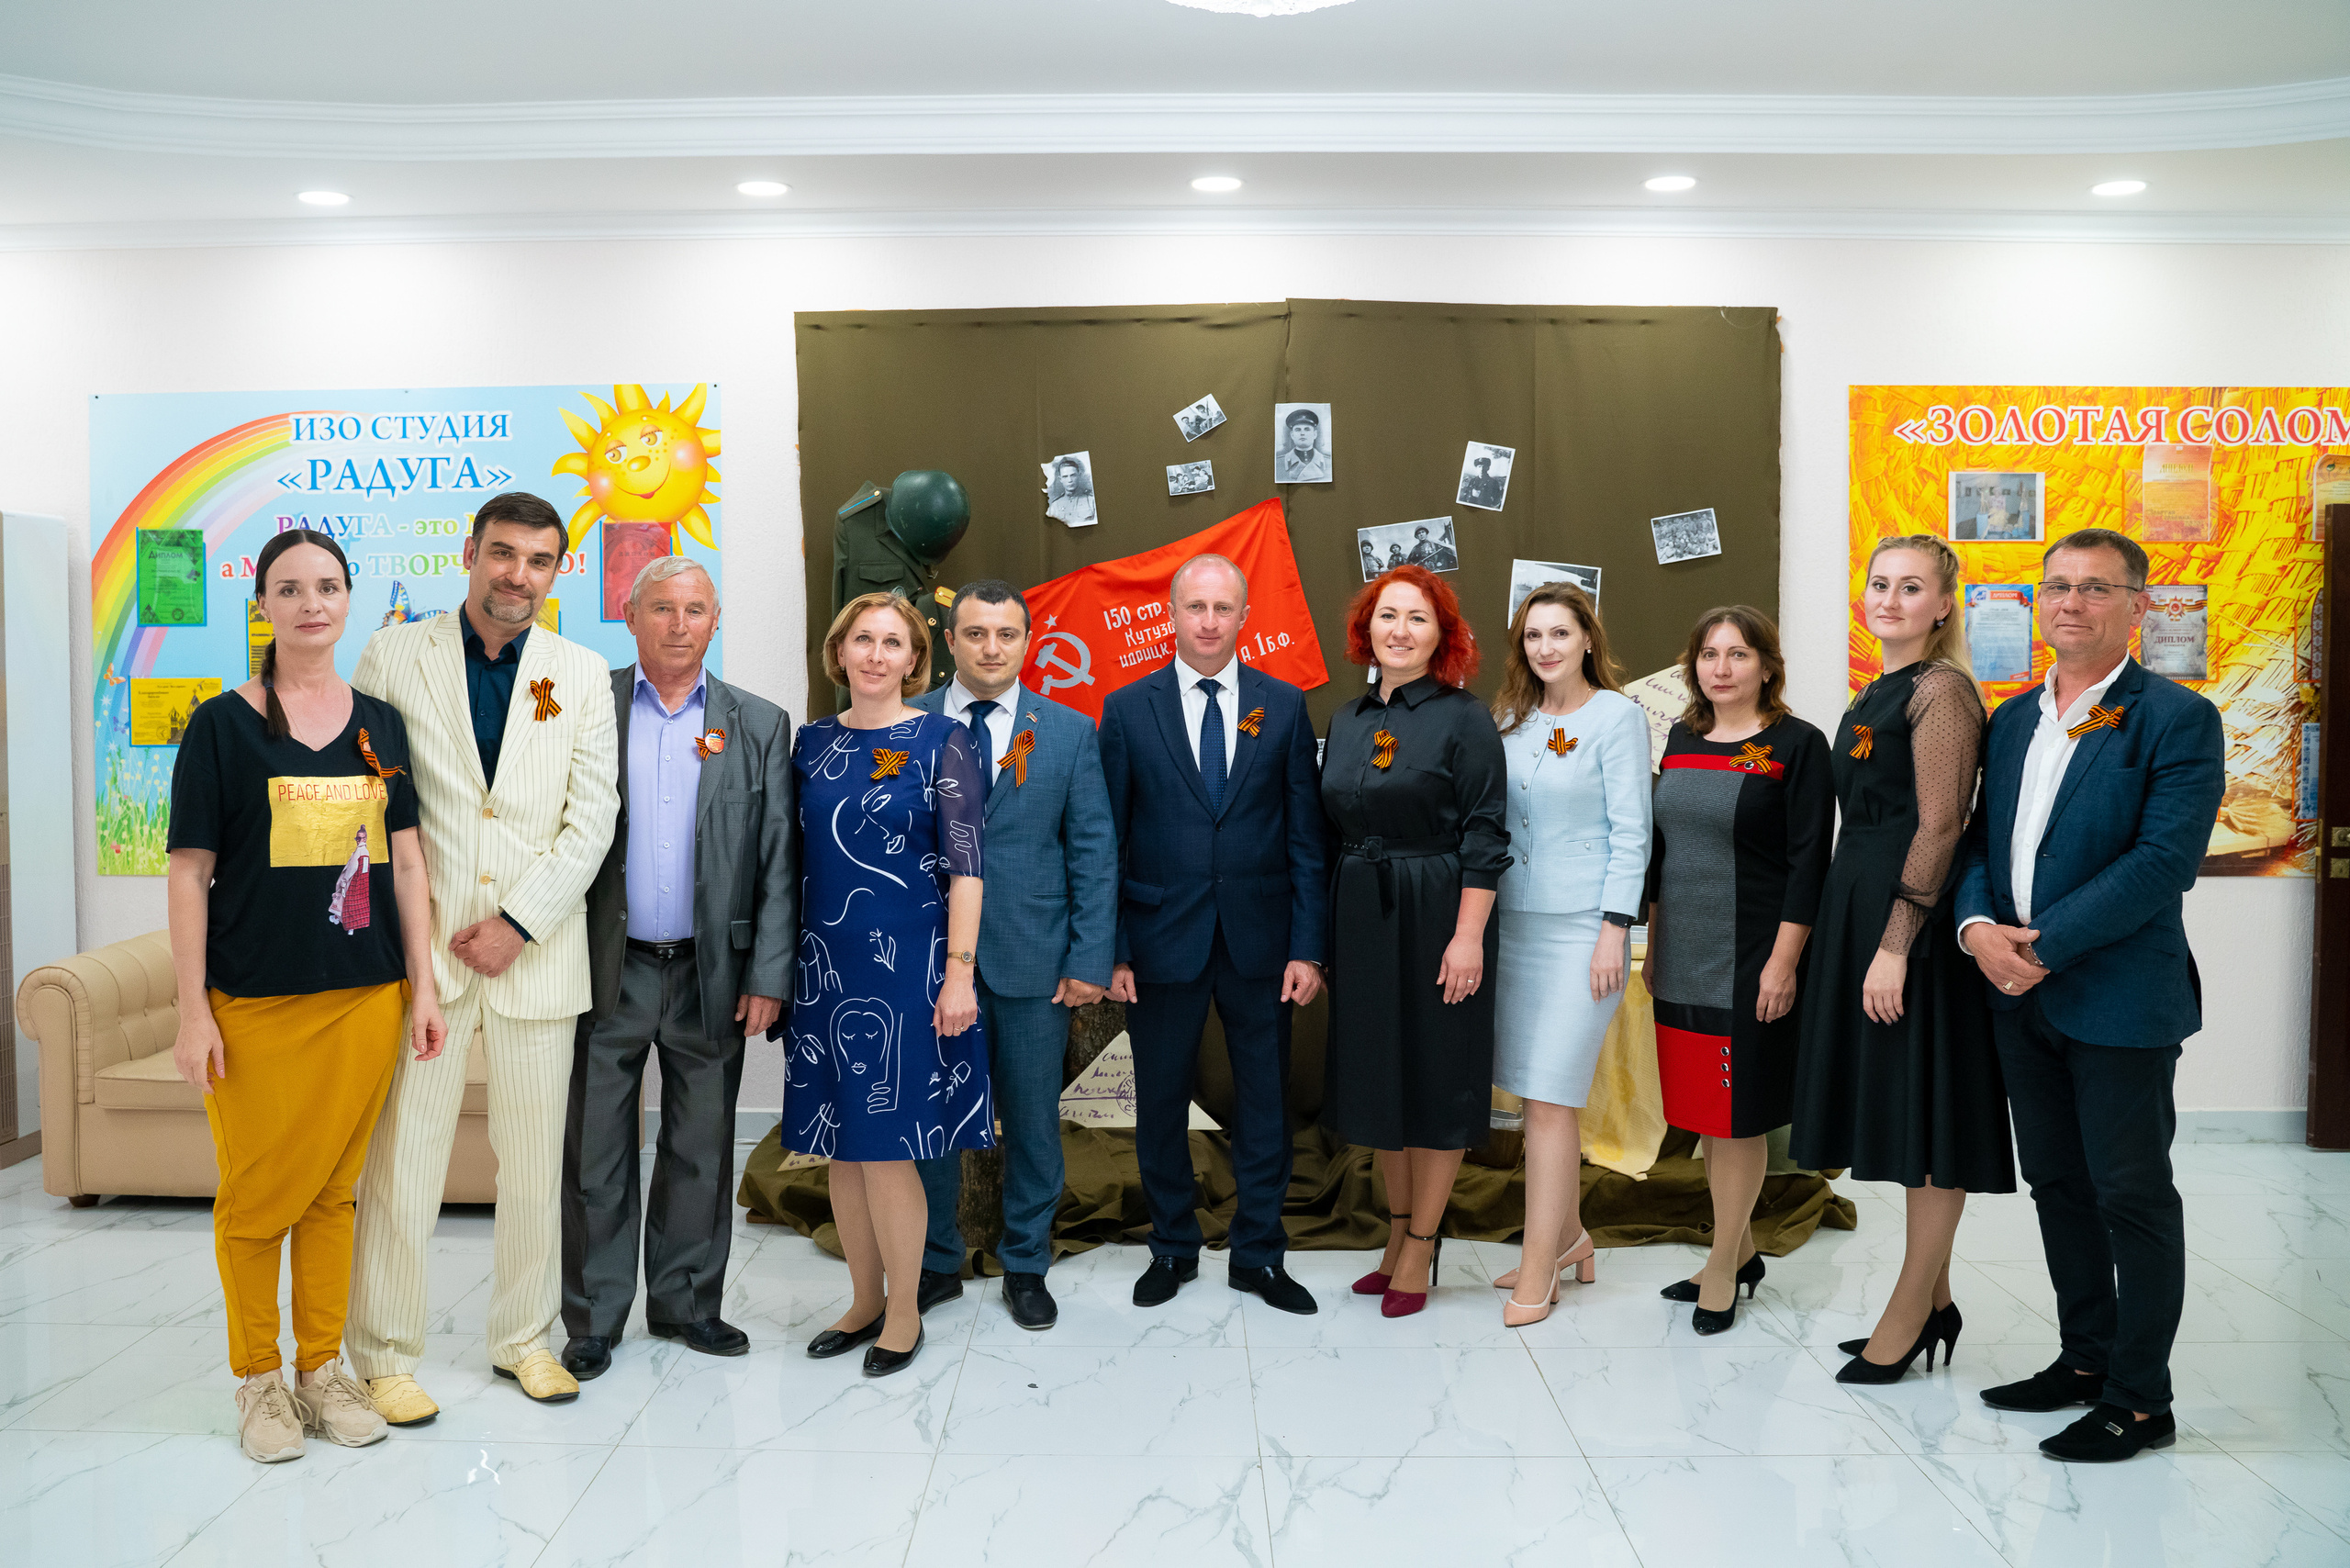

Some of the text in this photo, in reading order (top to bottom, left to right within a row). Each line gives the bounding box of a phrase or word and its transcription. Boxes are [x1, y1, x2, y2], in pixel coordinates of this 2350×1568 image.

[293, 414, 509, 444] ИЗО СТУДИЯ
[1897, 407, 2167, 443] «ЗОЛОТАЯ
[276, 456, 512, 498] «РАДУГА»
[276, 515, 394, 541] РАДУГА
[415, 520, 458, 535] это
[221, 563, 234, 577] а
[1102, 605, 1131, 631] 150
[2154, 635, 2195, 644] ДИПЛОМ
[278, 783, 386, 801] PEACE AND LOVE
